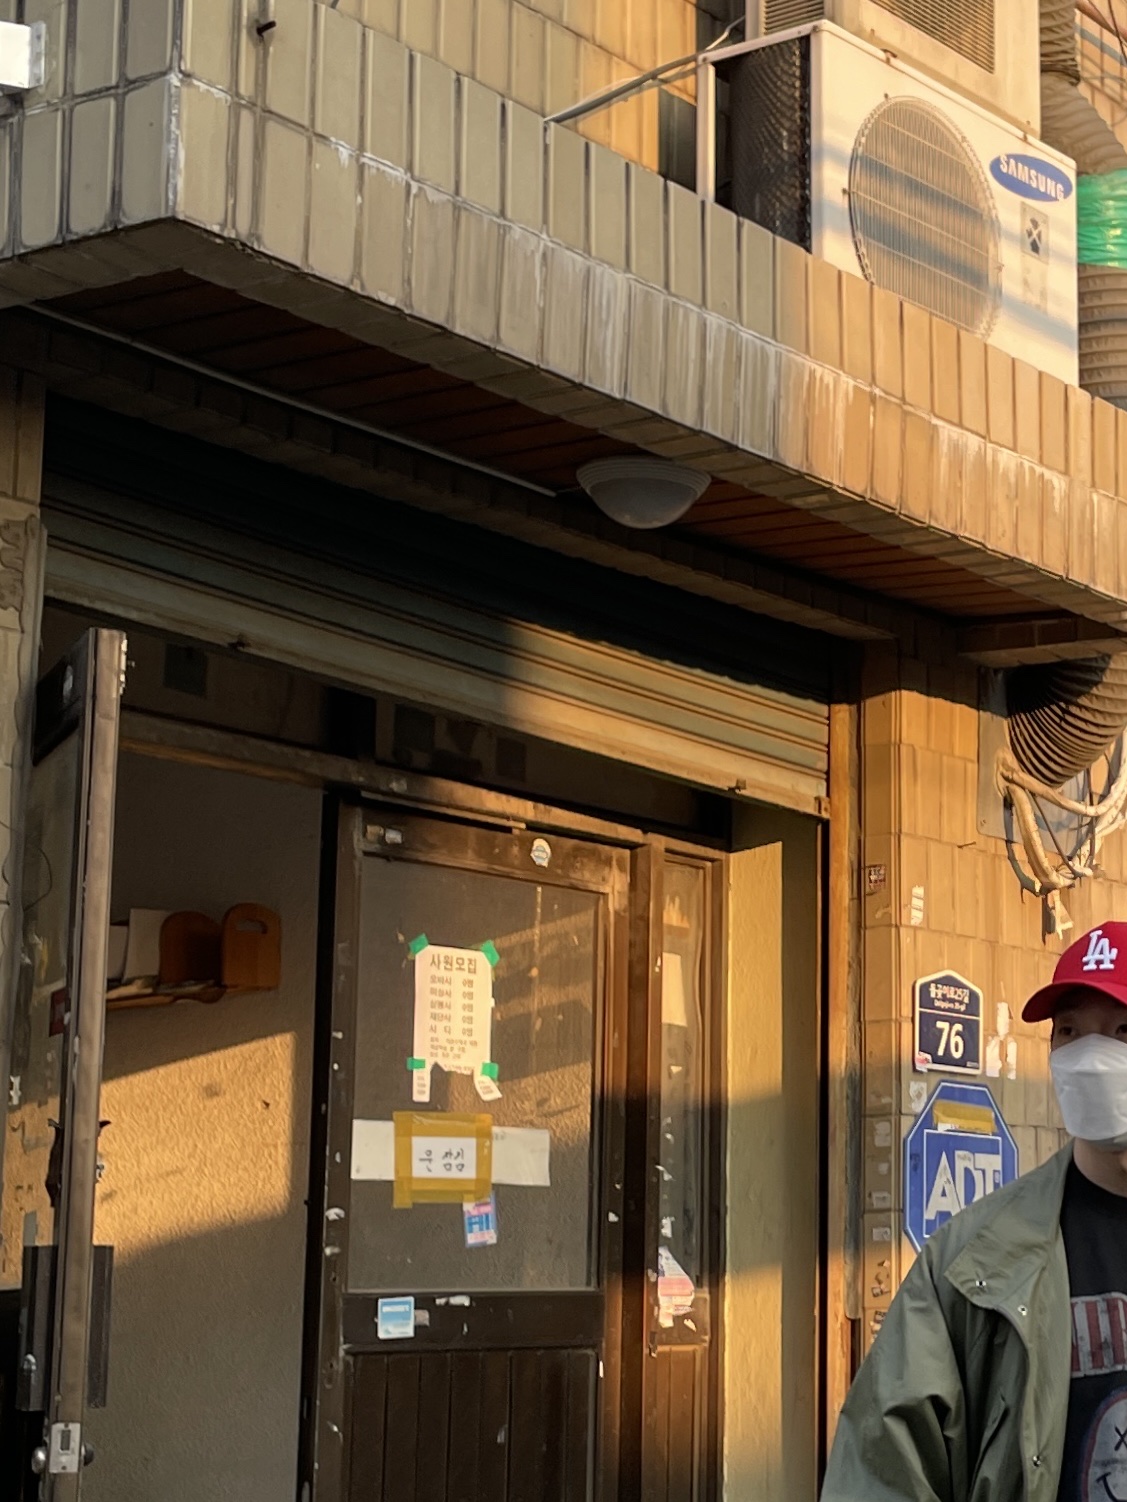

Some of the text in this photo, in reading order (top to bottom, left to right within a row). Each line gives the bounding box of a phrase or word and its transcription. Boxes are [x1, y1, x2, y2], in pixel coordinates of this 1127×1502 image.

[1000, 154, 1065, 200] SAMSUNG
[429, 953, 477, 974] 사원모집
[1082, 930, 1118, 971] LA
[936, 1021, 964, 1059] 76
[925, 1150, 1001, 1220] ADT
